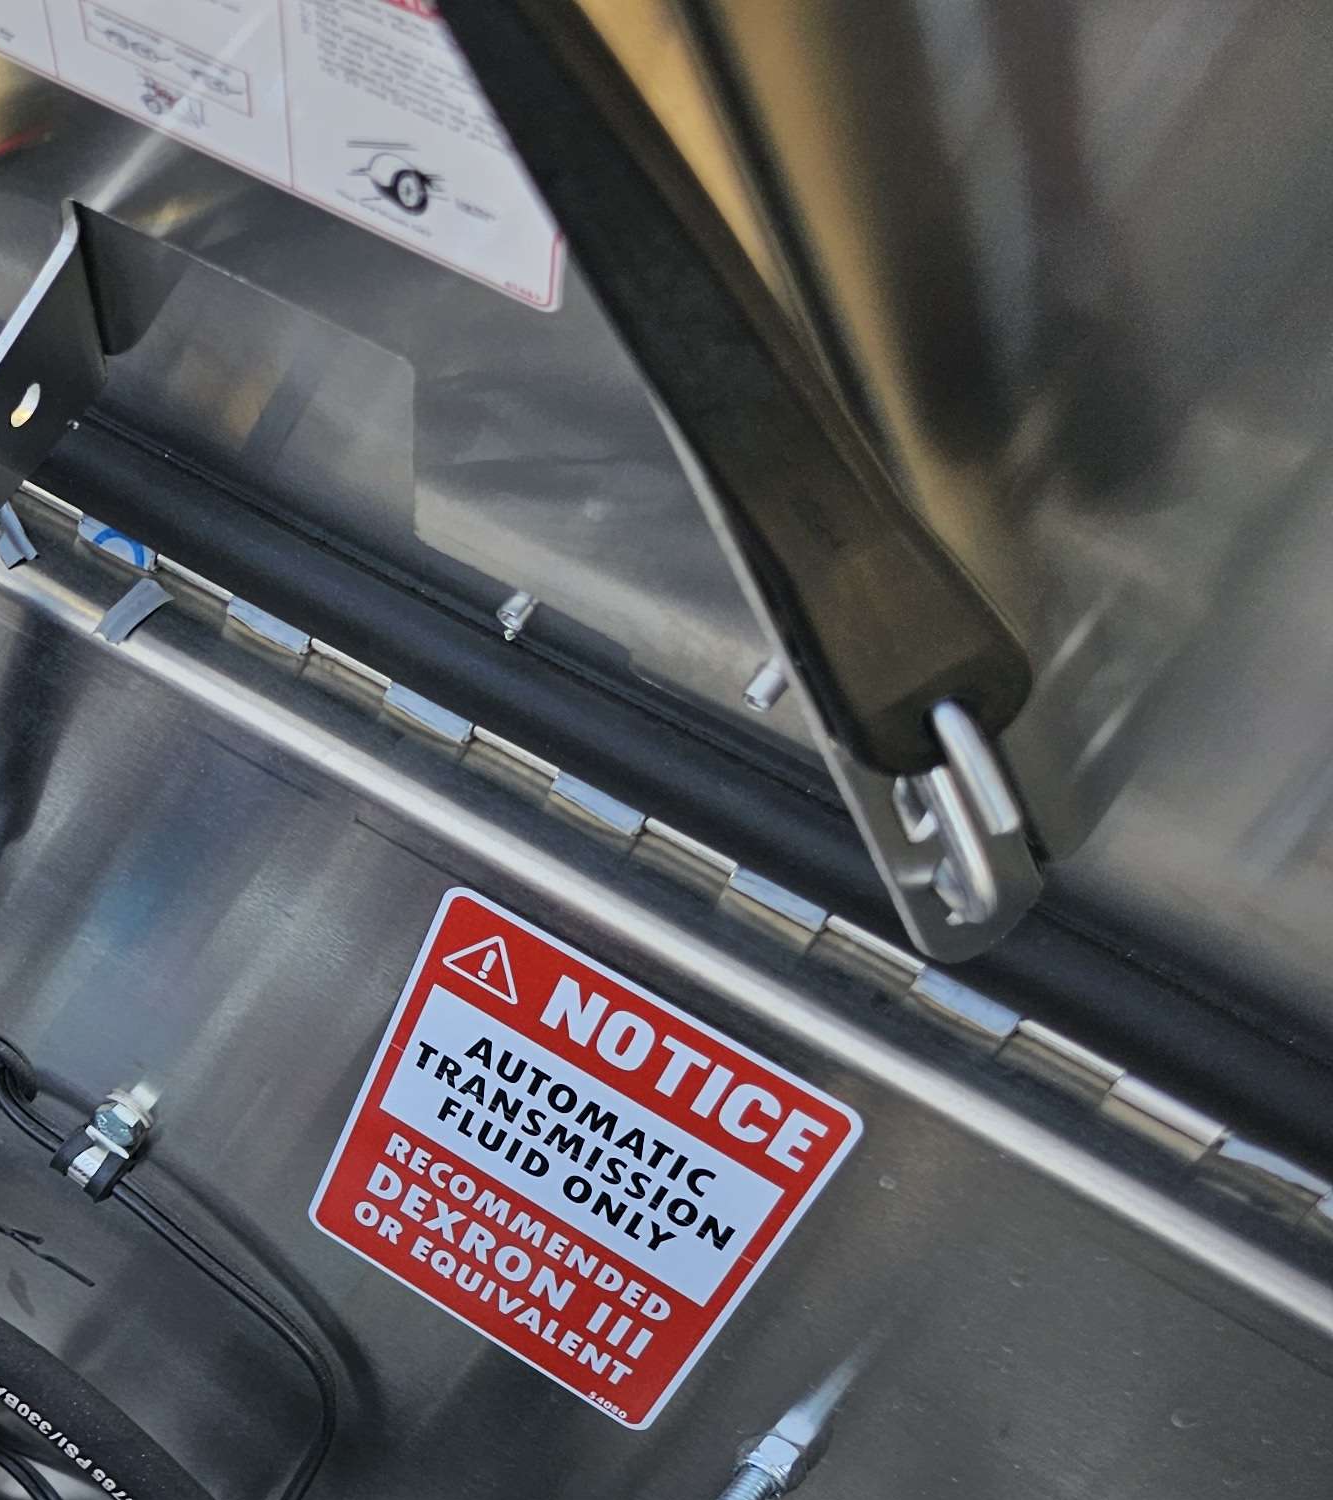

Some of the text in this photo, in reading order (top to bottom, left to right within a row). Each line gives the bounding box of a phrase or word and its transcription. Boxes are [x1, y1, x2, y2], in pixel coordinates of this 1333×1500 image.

[409, 1039, 739, 1251] TRANSMISSION
[462, 1031, 719, 1198] AUTOMATIC
[536, 972, 833, 1173] NOTICE
[364, 1160, 655, 1360] DEXRON III
[383, 1131, 677, 1326] RECOMMENDED
[435, 1095, 678, 1257] FLUID ONLY
[350, 1196, 634, 1390] OR EQUIVALENT
